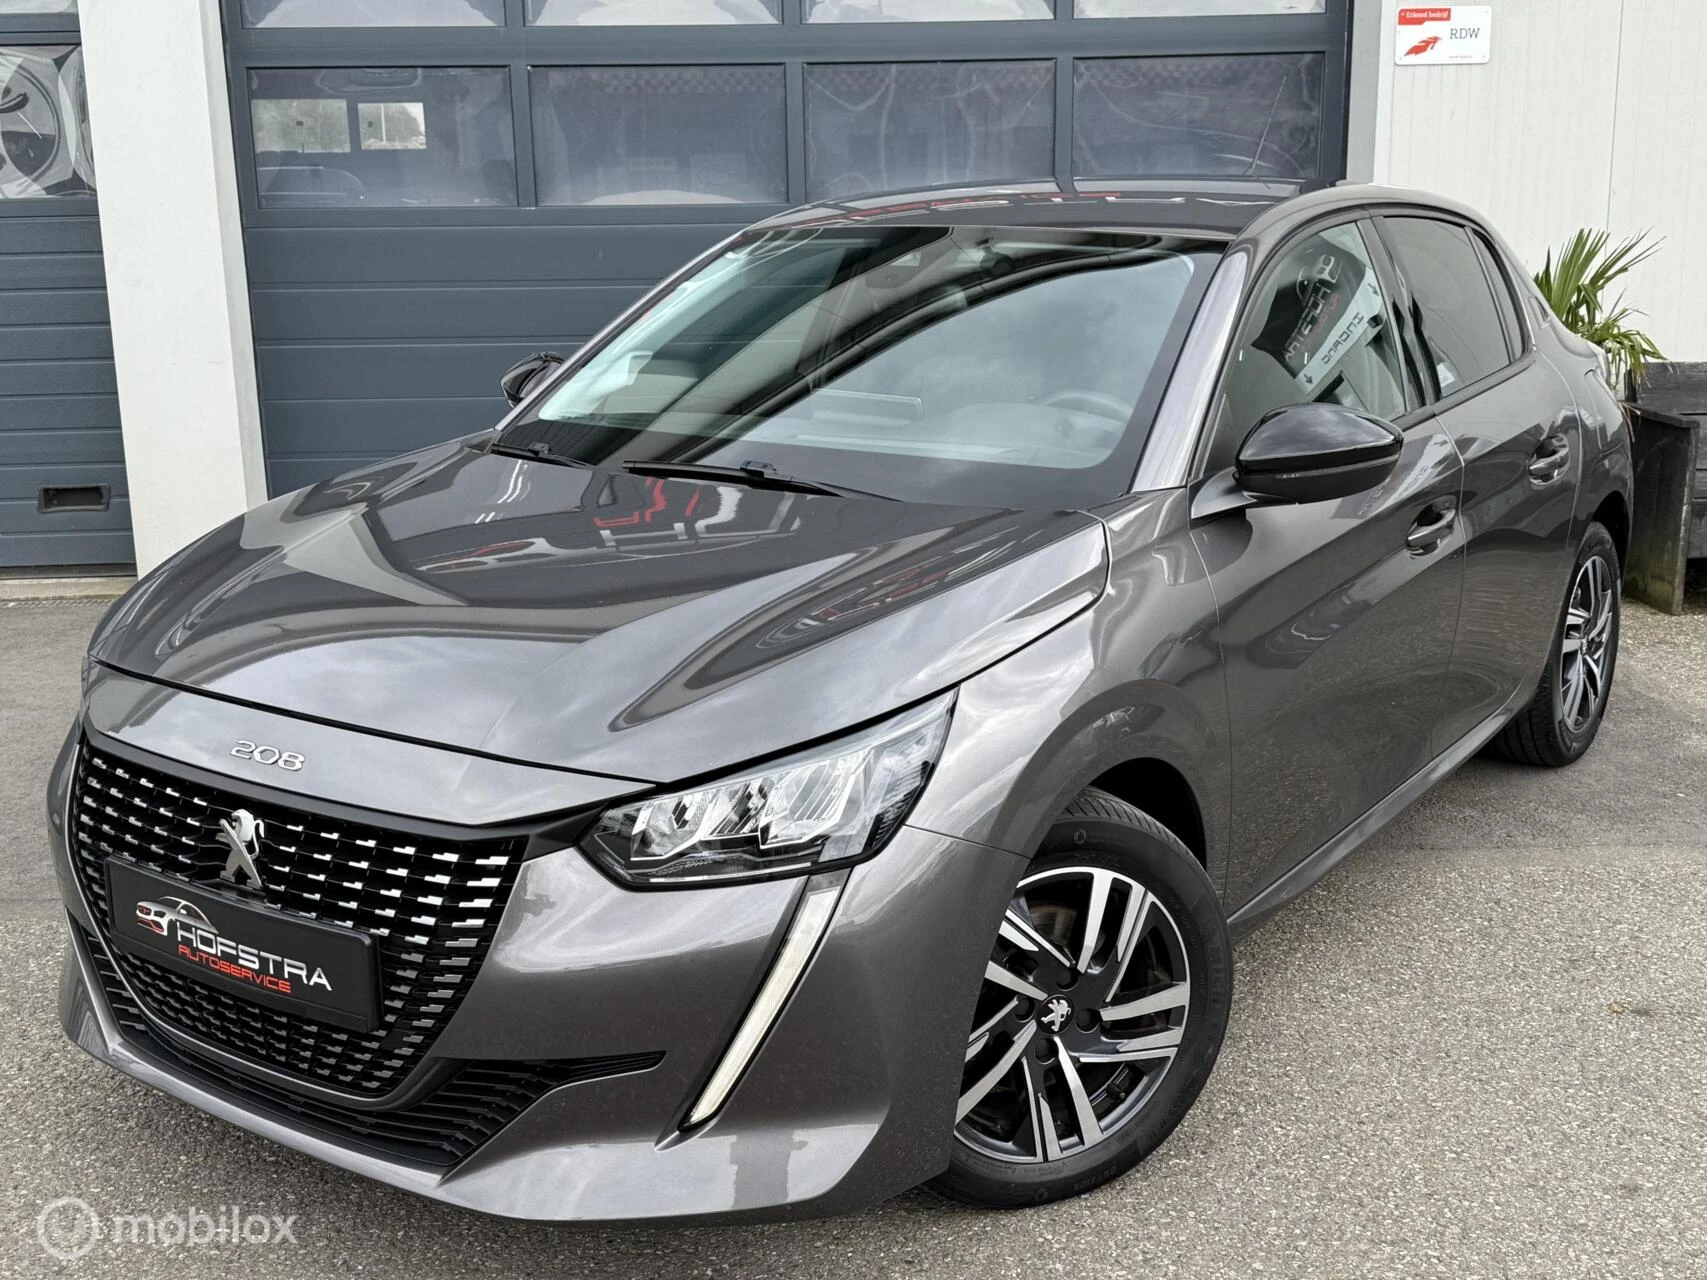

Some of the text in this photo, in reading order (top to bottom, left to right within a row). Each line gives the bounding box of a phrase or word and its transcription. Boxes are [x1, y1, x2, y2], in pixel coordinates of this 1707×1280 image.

[1429, 10, 1449, 19] bedrijf
[1449, 27, 1480, 40] RDW
[230, 740, 305, 771] 208
[176, 921, 333, 991] HOFSTRA
[178, 944, 293, 994] AUTOSERVICE
